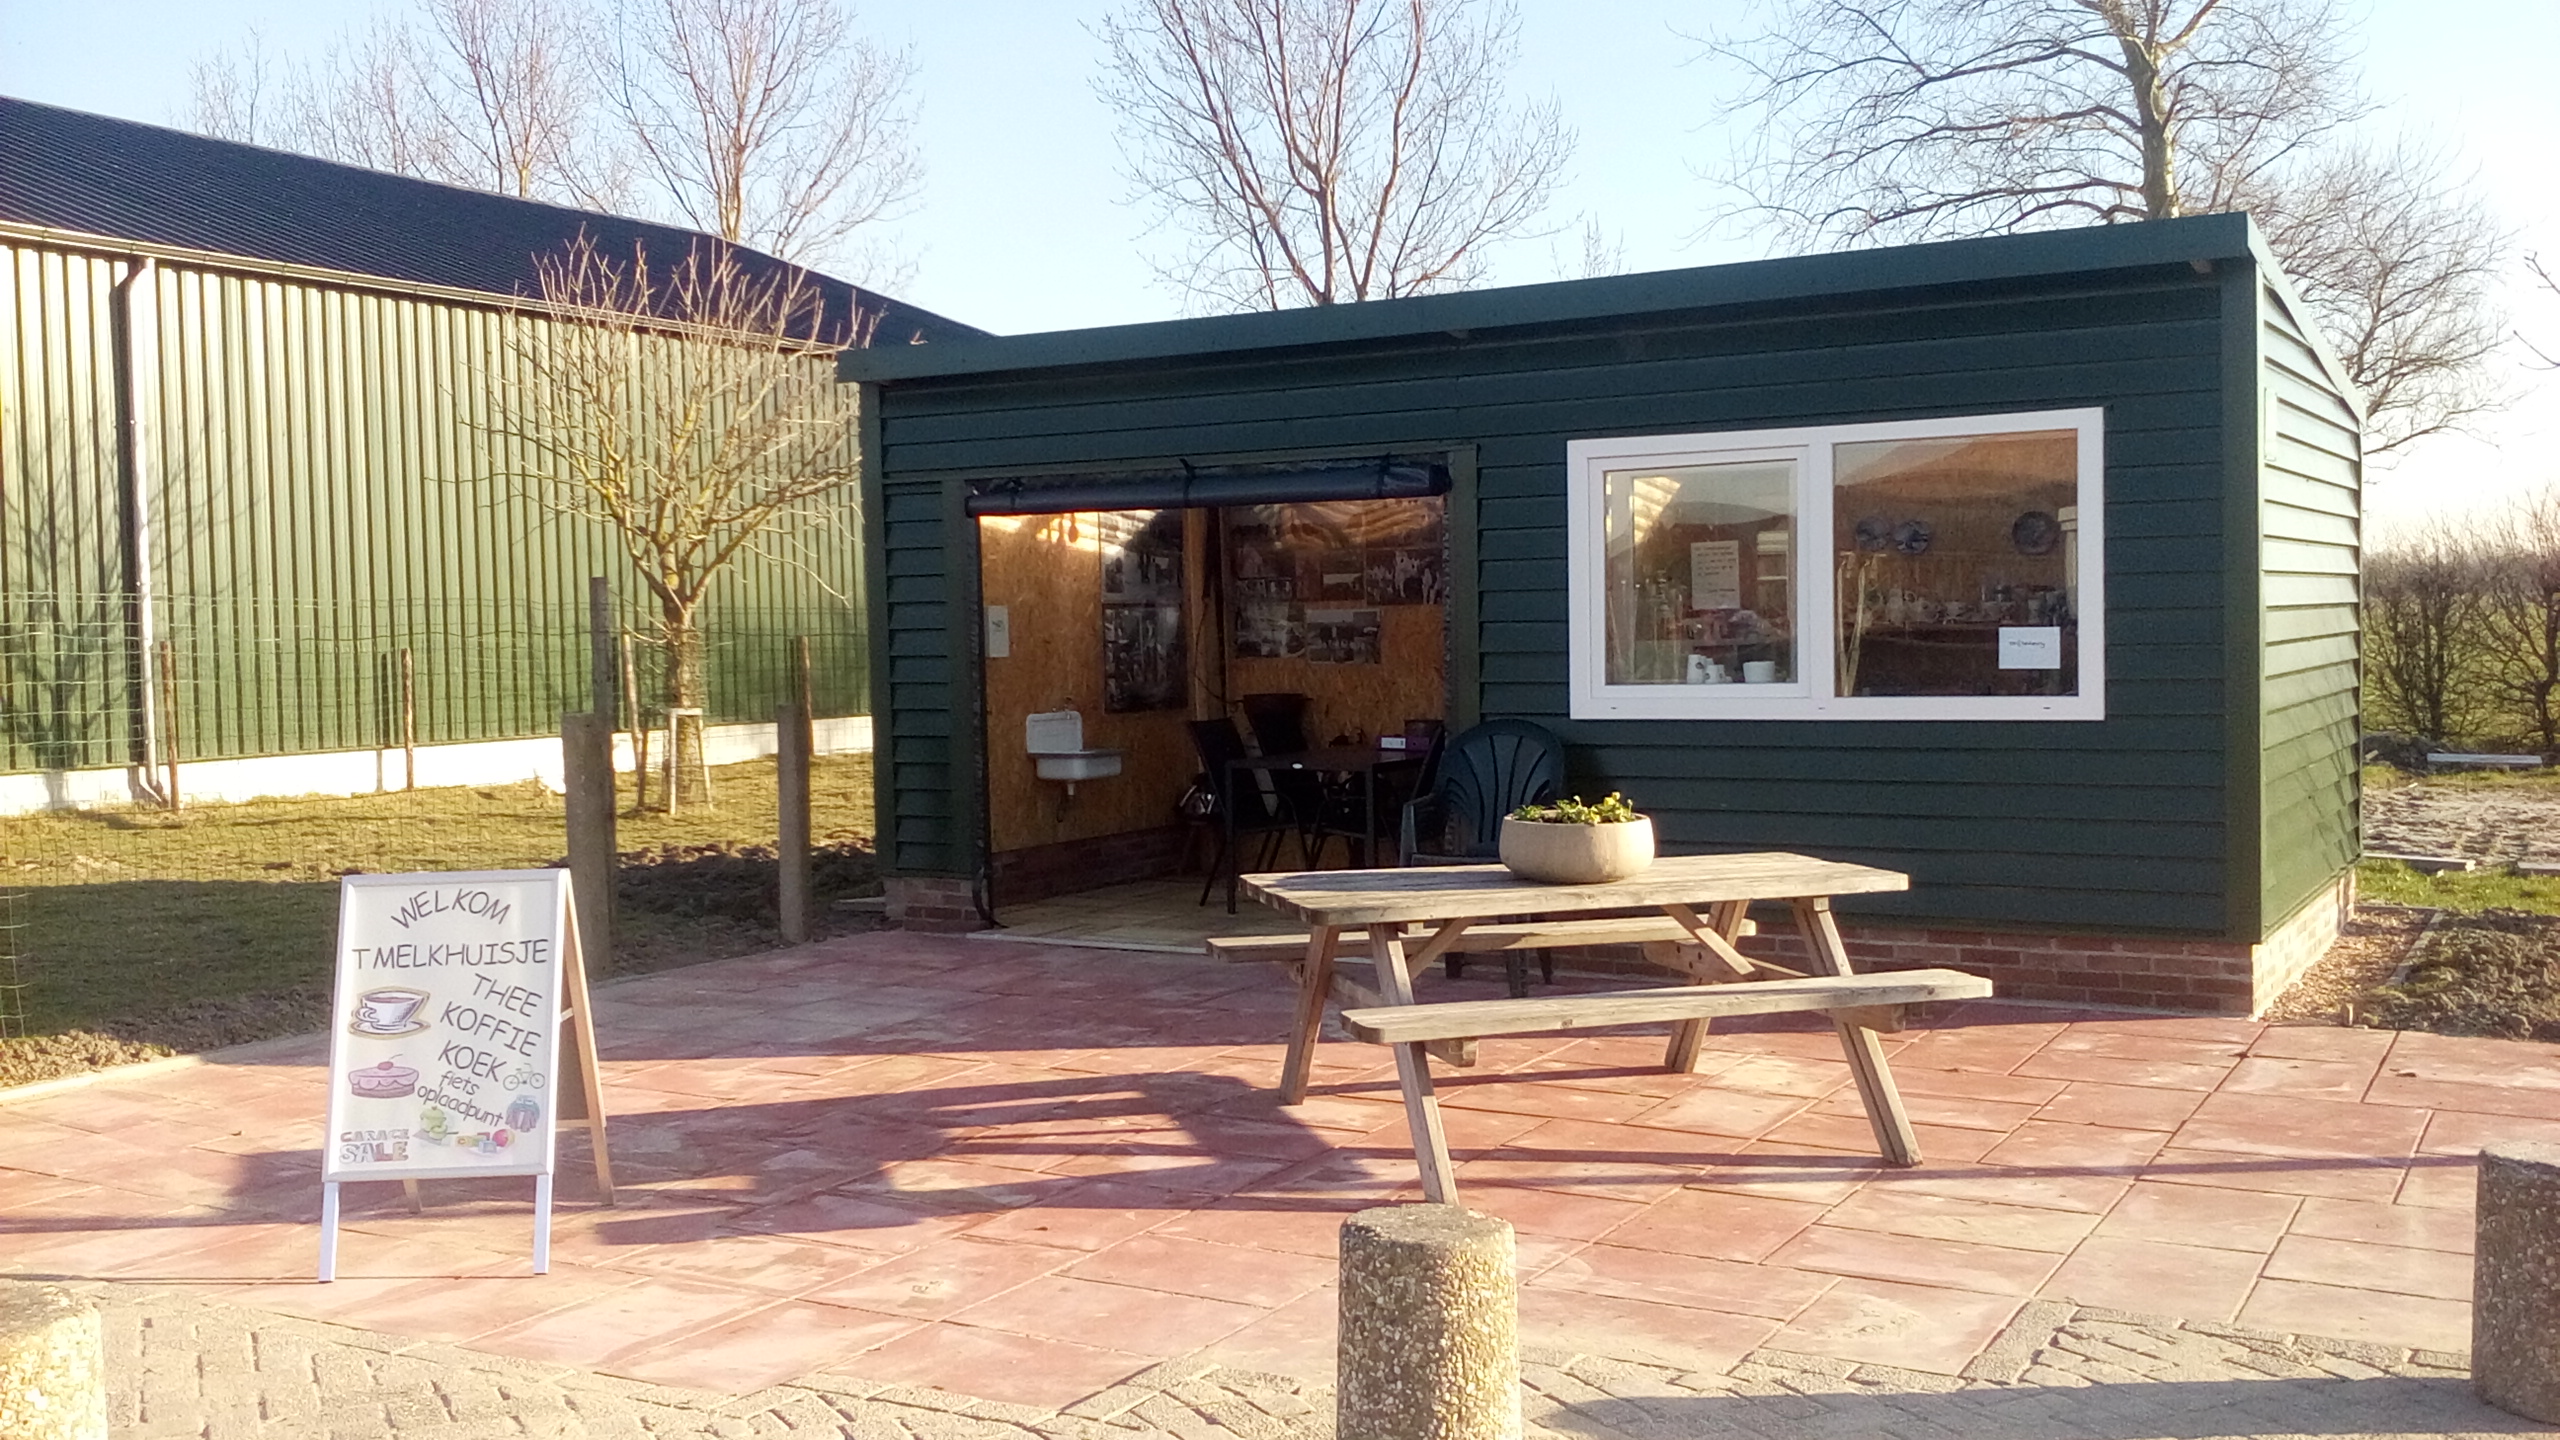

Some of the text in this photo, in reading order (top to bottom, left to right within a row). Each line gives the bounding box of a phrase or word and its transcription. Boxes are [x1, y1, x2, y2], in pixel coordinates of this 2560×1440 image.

[391, 888, 511, 929] WELKOM
[473, 973, 543, 1018] THEE
[440, 1001, 542, 1057] KOFFIE
[438, 1039, 507, 1082] KOEK
[438, 1070, 480, 1096] fiets
[417, 1085, 504, 1127] oplaadpunt
[339, 1141, 409, 1163] SALE
